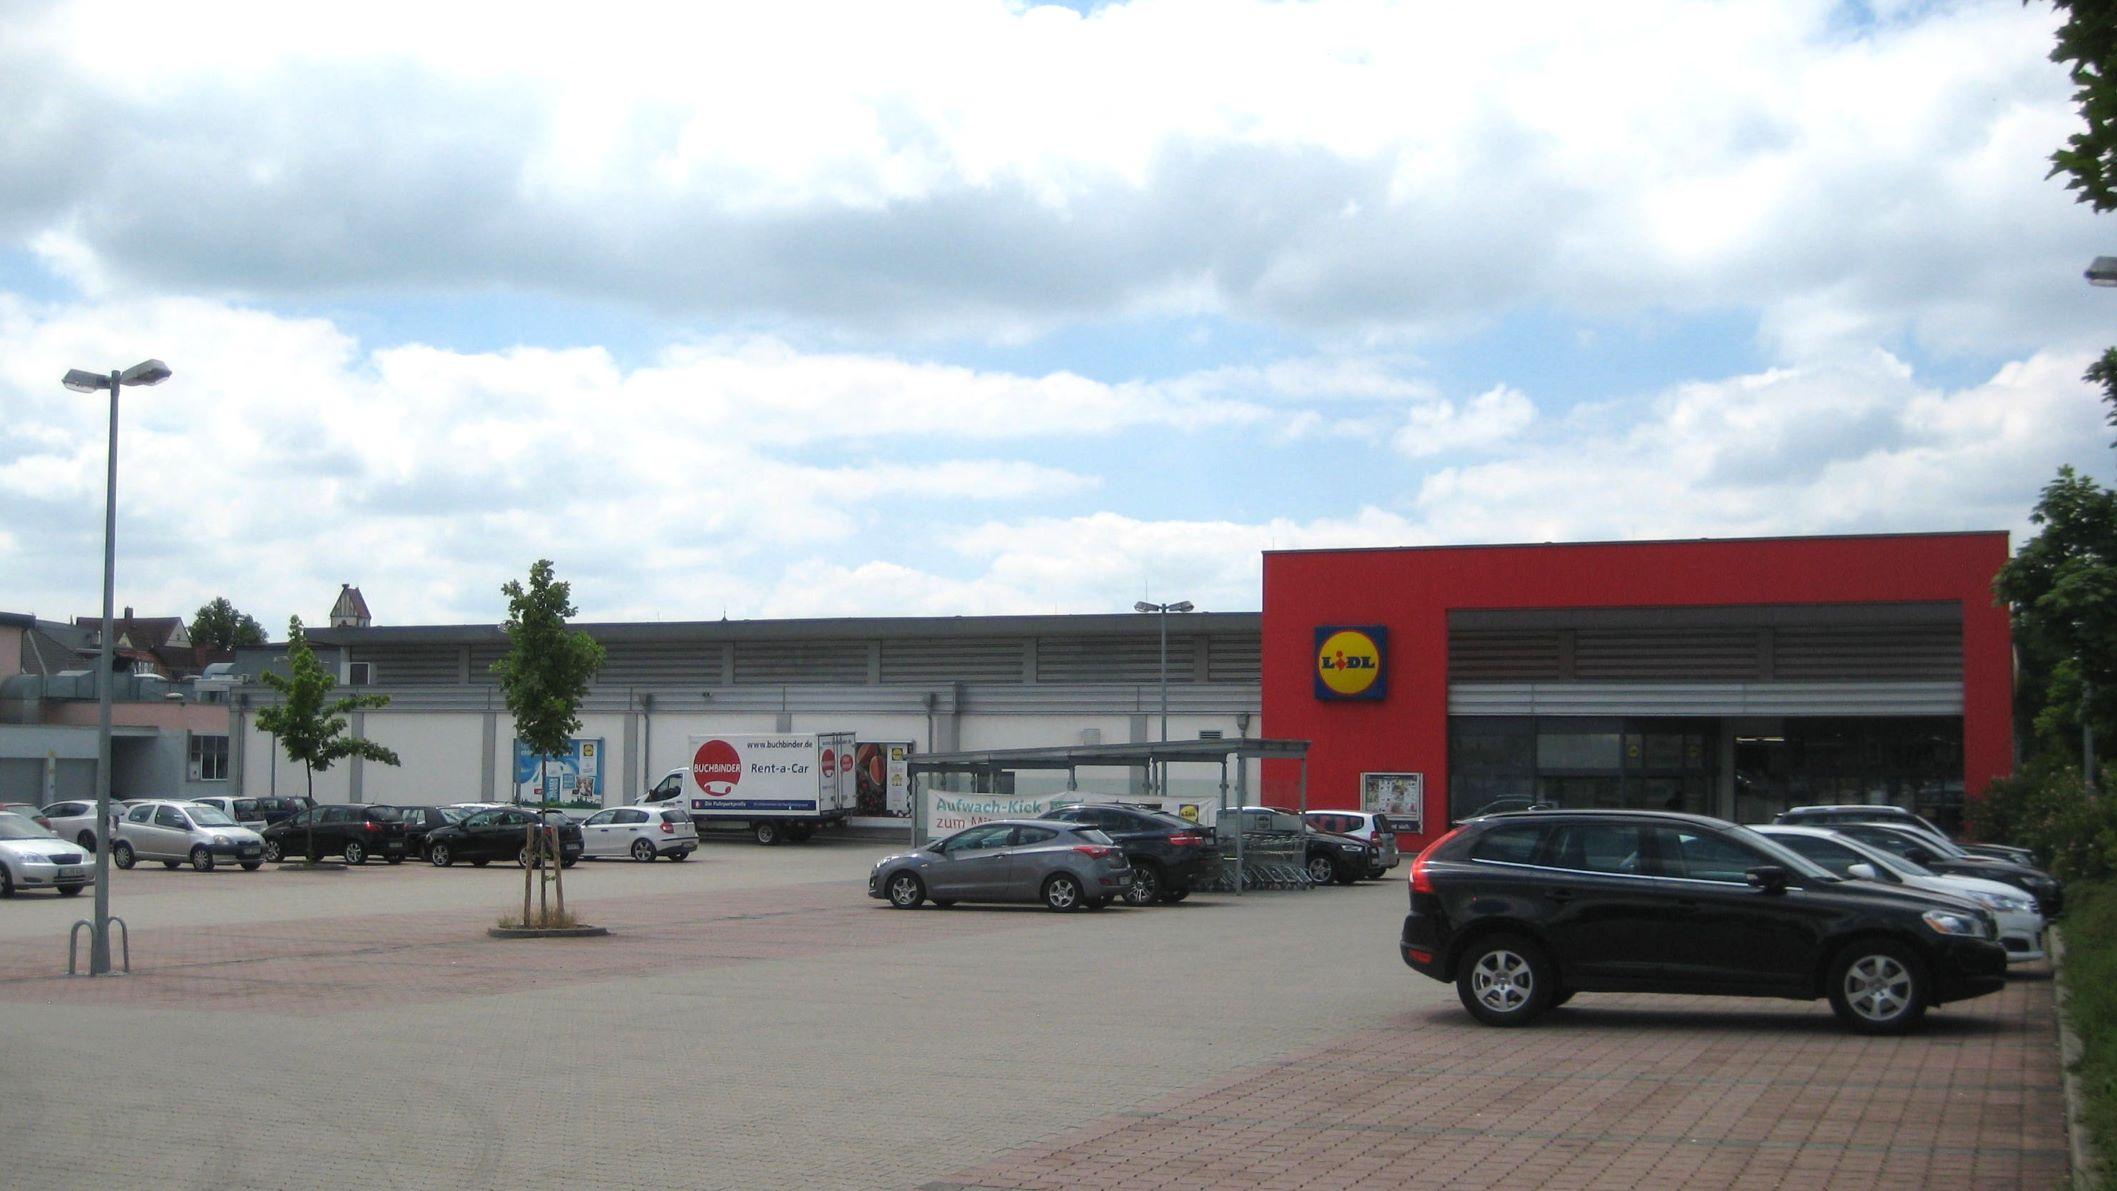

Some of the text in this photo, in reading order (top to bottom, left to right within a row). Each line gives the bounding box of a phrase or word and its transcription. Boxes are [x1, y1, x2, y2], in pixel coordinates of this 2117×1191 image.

[746, 740, 813, 749] www.buchbinder.de
[694, 763, 741, 773] BUCHBINDER
[751, 763, 809, 774] Rent-a-Car
[936, 818, 966, 829] zum
